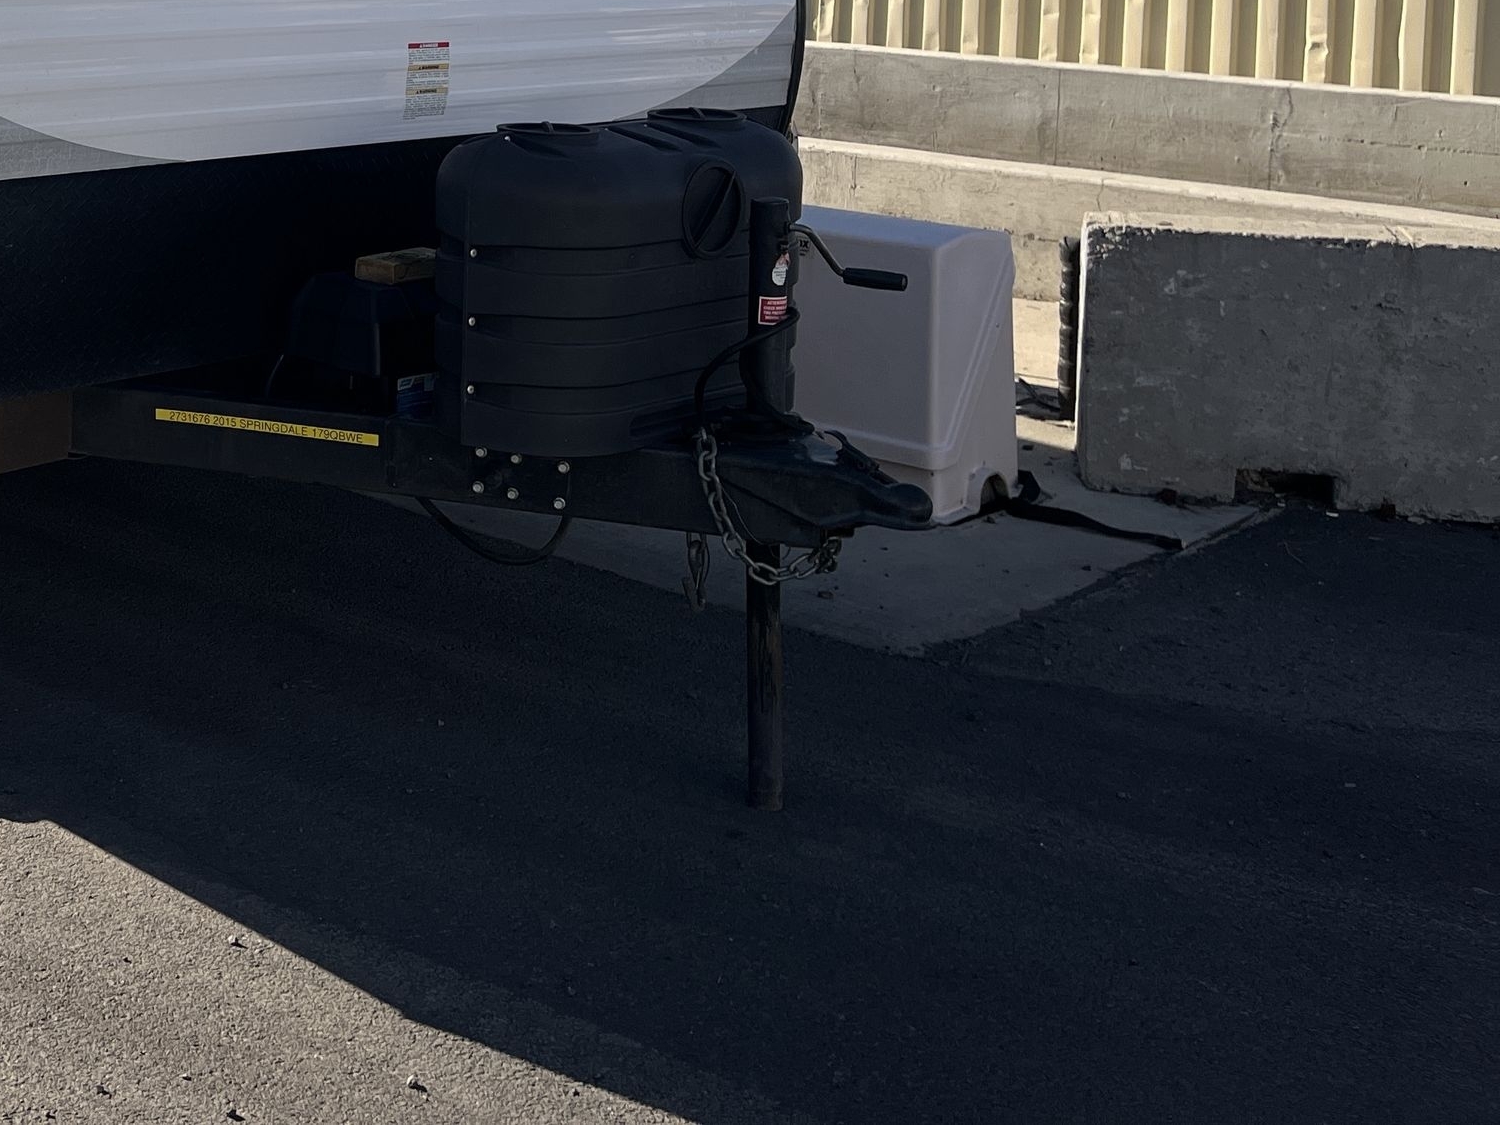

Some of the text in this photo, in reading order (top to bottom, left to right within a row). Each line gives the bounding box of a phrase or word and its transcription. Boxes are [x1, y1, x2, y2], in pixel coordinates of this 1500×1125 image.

[169, 411, 363, 444] 2731676 2015 SPRINGDALE 179QBWE
